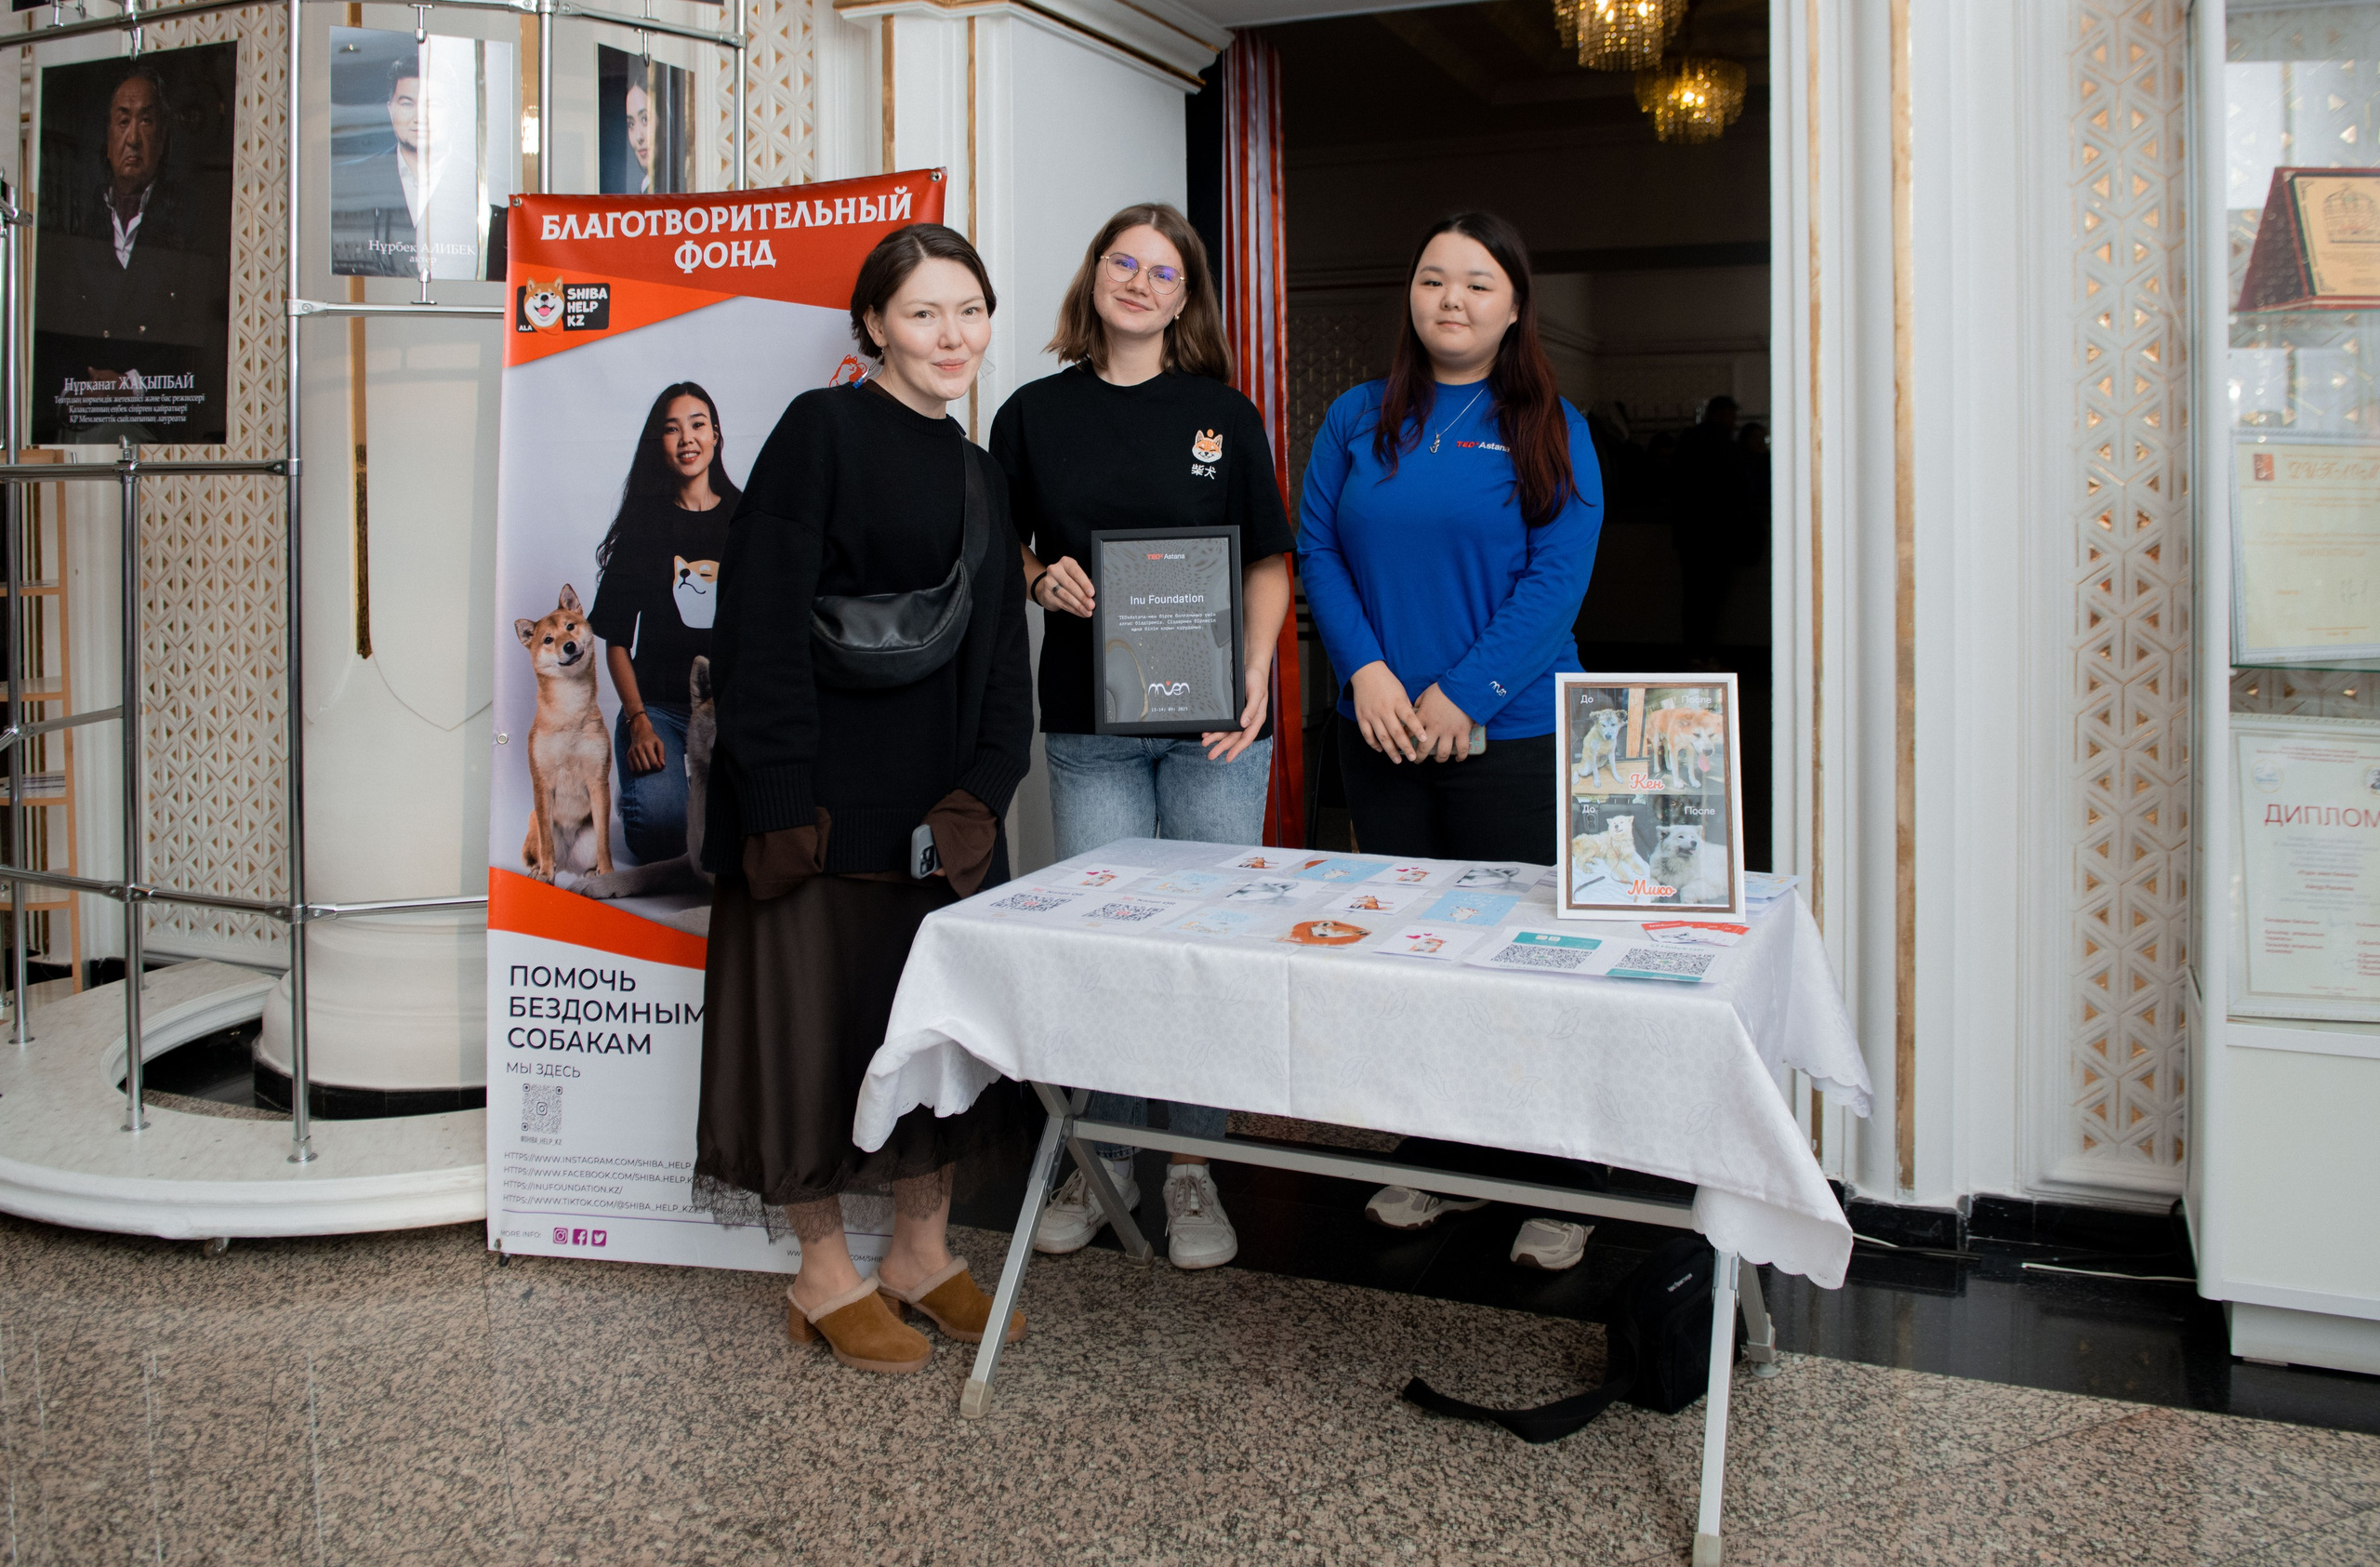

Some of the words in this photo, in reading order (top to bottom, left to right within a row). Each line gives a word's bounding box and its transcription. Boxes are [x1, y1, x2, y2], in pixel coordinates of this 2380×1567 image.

[540, 186, 914, 240] БЛАГОТВОРИТЕЛЬНЫЙ
[420, 243, 476, 256] АЛИБЕК
[674, 239, 776, 273] ФОНД
[566, 286, 608, 300] SHIBA
[566, 300, 599, 313] HELP
[566, 314, 585, 326] KZ
[1191, 463, 1217, 480] 柴犬
[1130, 595, 1145, 605] Inu
[1148, 593, 1204, 604] Foundation
[1580, 695, 1594, 704] До
[1629, 773, 1665, 790] Кен
[1582, 804, 1596, 814] До
[1684, 805, 1716, 816] После
[1627, 879, 1677, 897] Мико
[510, 964, 637, 992] ПОМОЧЬ
[509, 996, 705, 1025] БЕЗДОМНЫМ
[508, 1027, 652, 1055] СОБАКАМ
[507, 1062, 532, 1074] МЫ
[536, 1063, 581, 1078] ЗДЕСЬ
[504, 1151, 694, 1171] HTTPS://WWW.INSTAGRAM.COM/SHIBA_HELP_
[503, 1166, 694, 1184] HTTPS://WWW.FACEBOOK.COM/SHIBA.HELP.K
